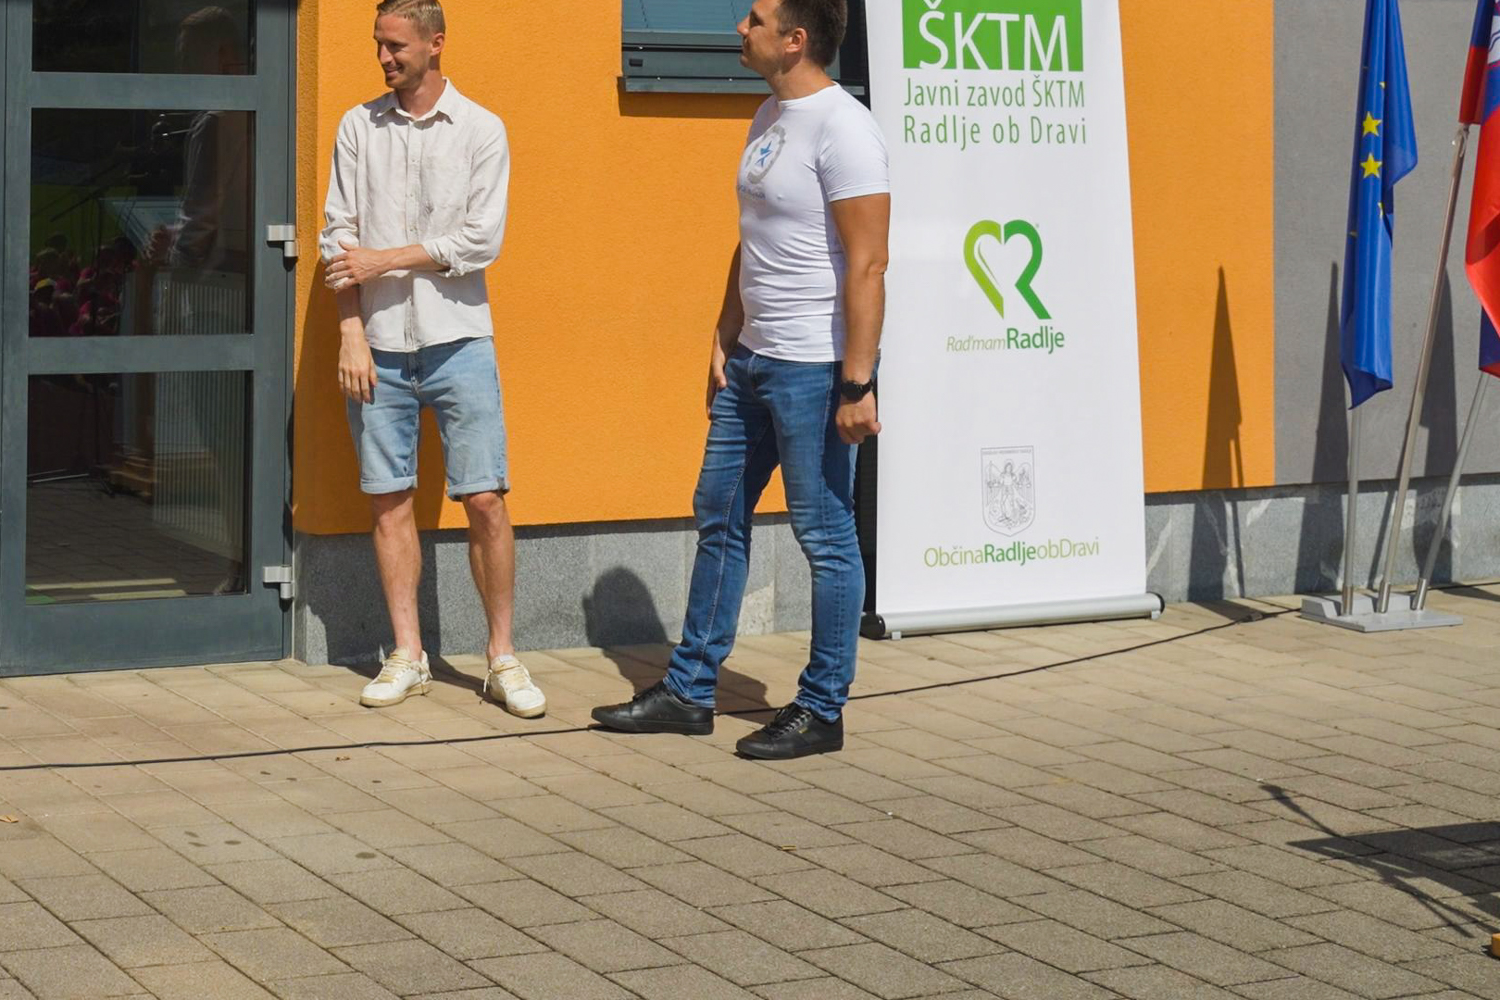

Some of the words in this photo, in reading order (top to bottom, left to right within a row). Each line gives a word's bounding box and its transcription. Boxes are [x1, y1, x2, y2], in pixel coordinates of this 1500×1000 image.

[904, 77, 959, 107] Javni
[966, 79, 1026, 107] zavod
[1032, 74, 1086, 108] ŠKTM
[903, 114, 981, 151] Radlje
[992, 115, 1020, 144] ob
[1030, 116, 1086, 145] Dravi
